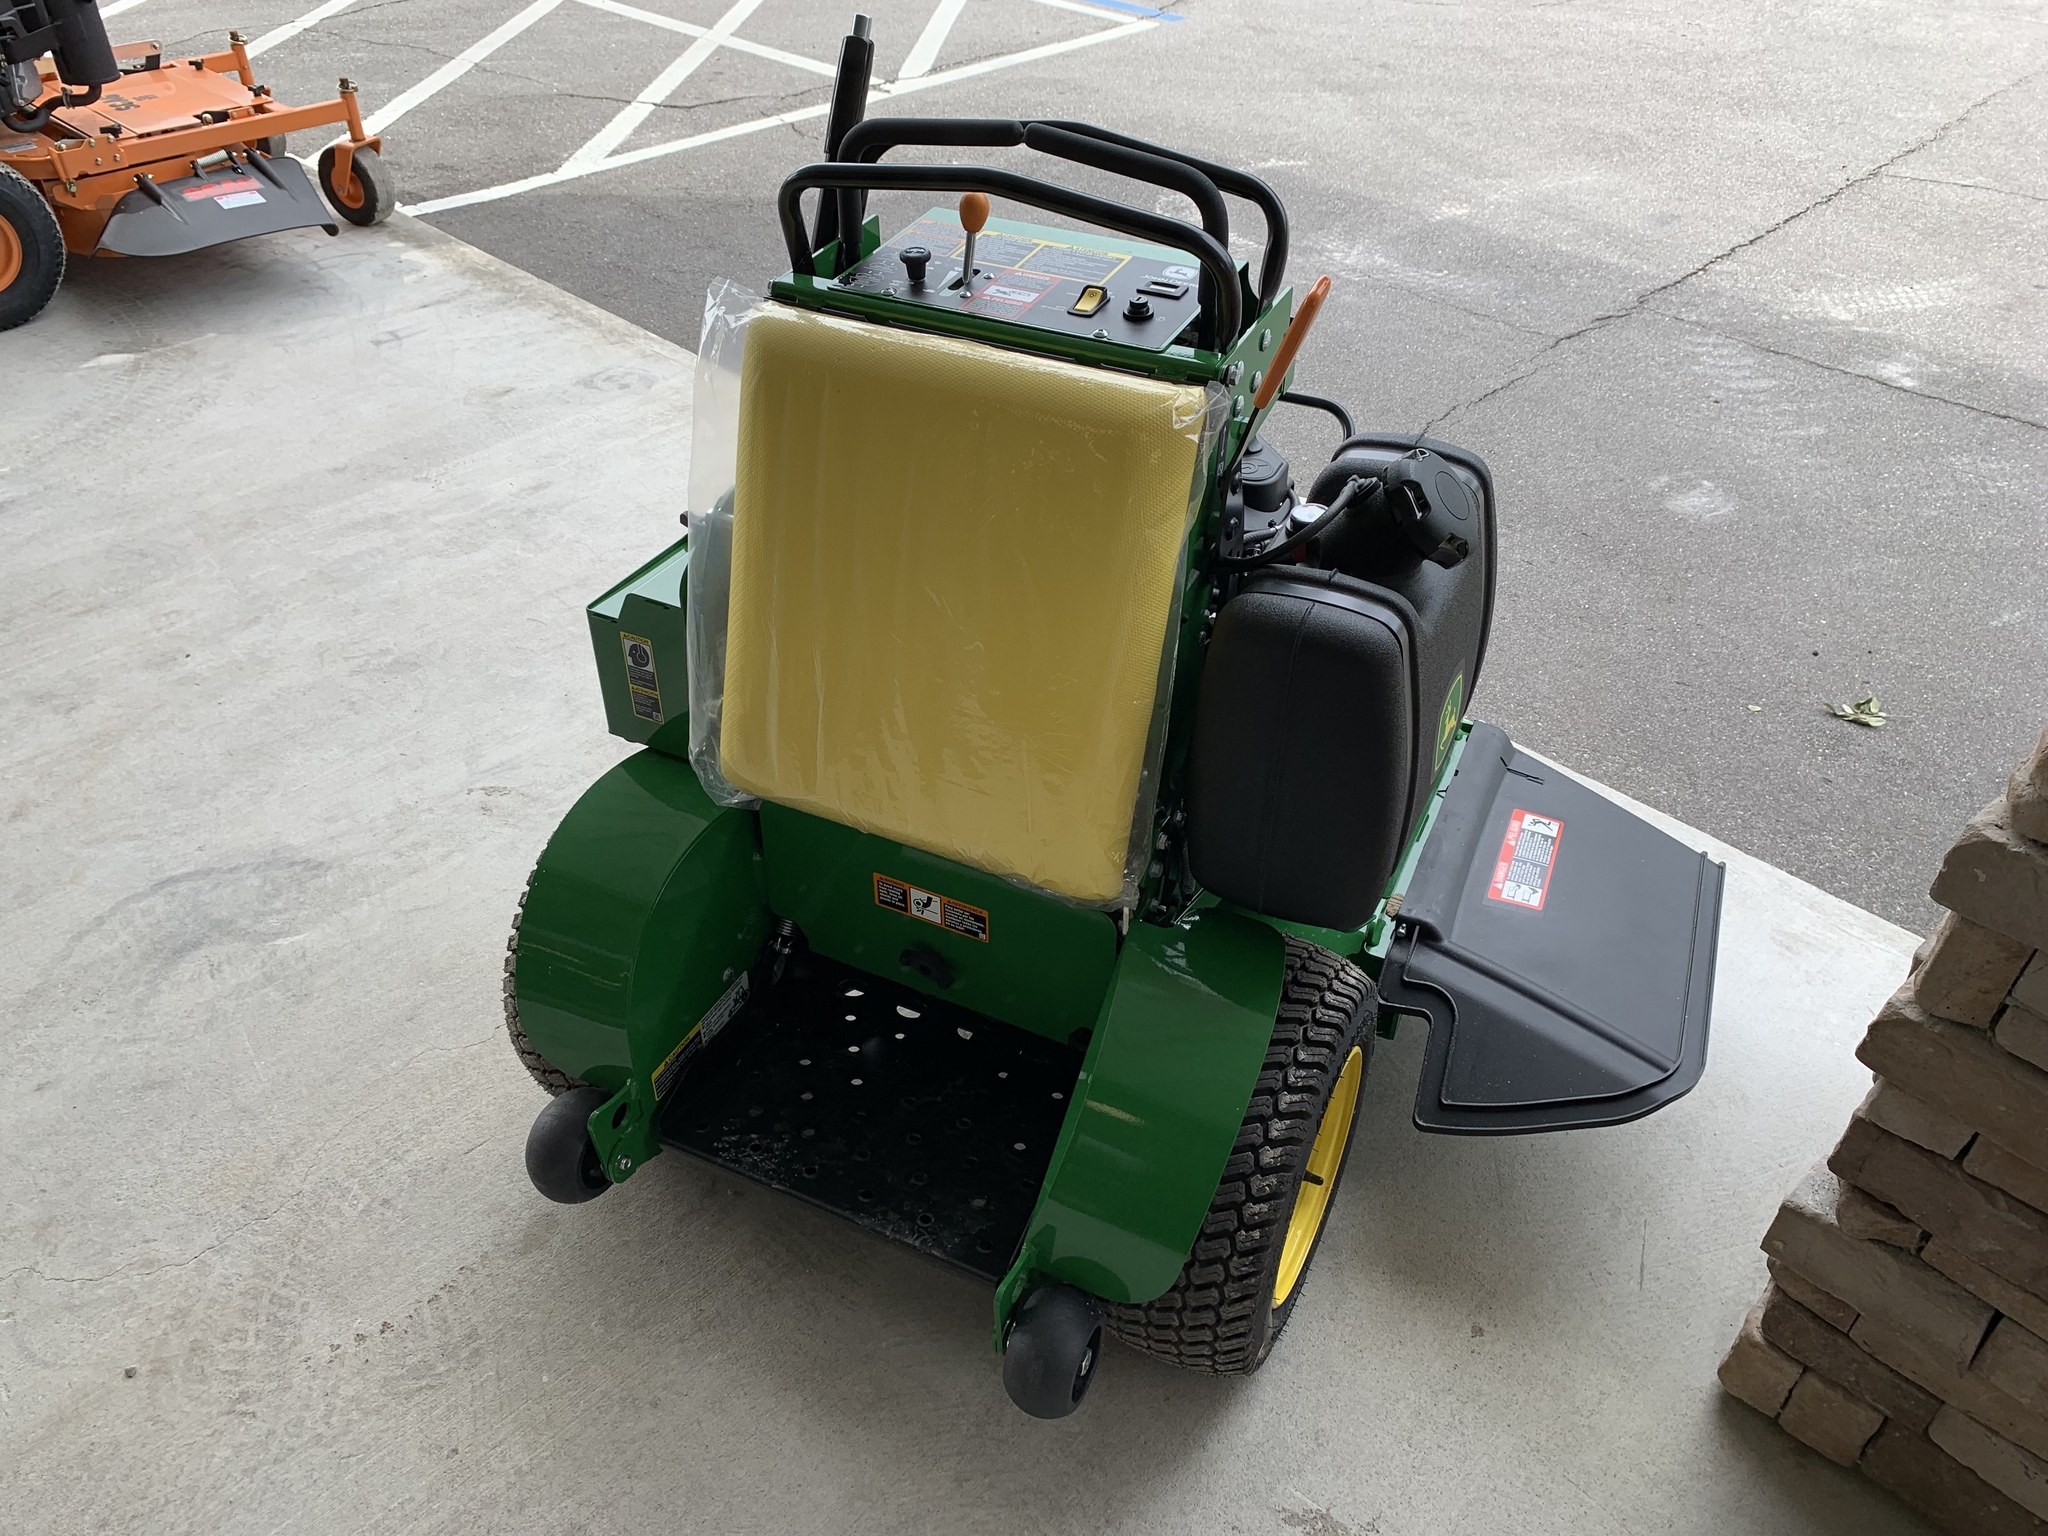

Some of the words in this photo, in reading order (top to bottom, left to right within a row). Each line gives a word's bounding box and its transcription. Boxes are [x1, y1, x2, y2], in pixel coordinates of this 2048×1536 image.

[1022, 272, 1050, 281] DANGER
[1140, 274, 1169, 283] JOHN
[991, 297, 1023, 306] PELIGRO
[668, 1035, 691, 1062] CAUTION
